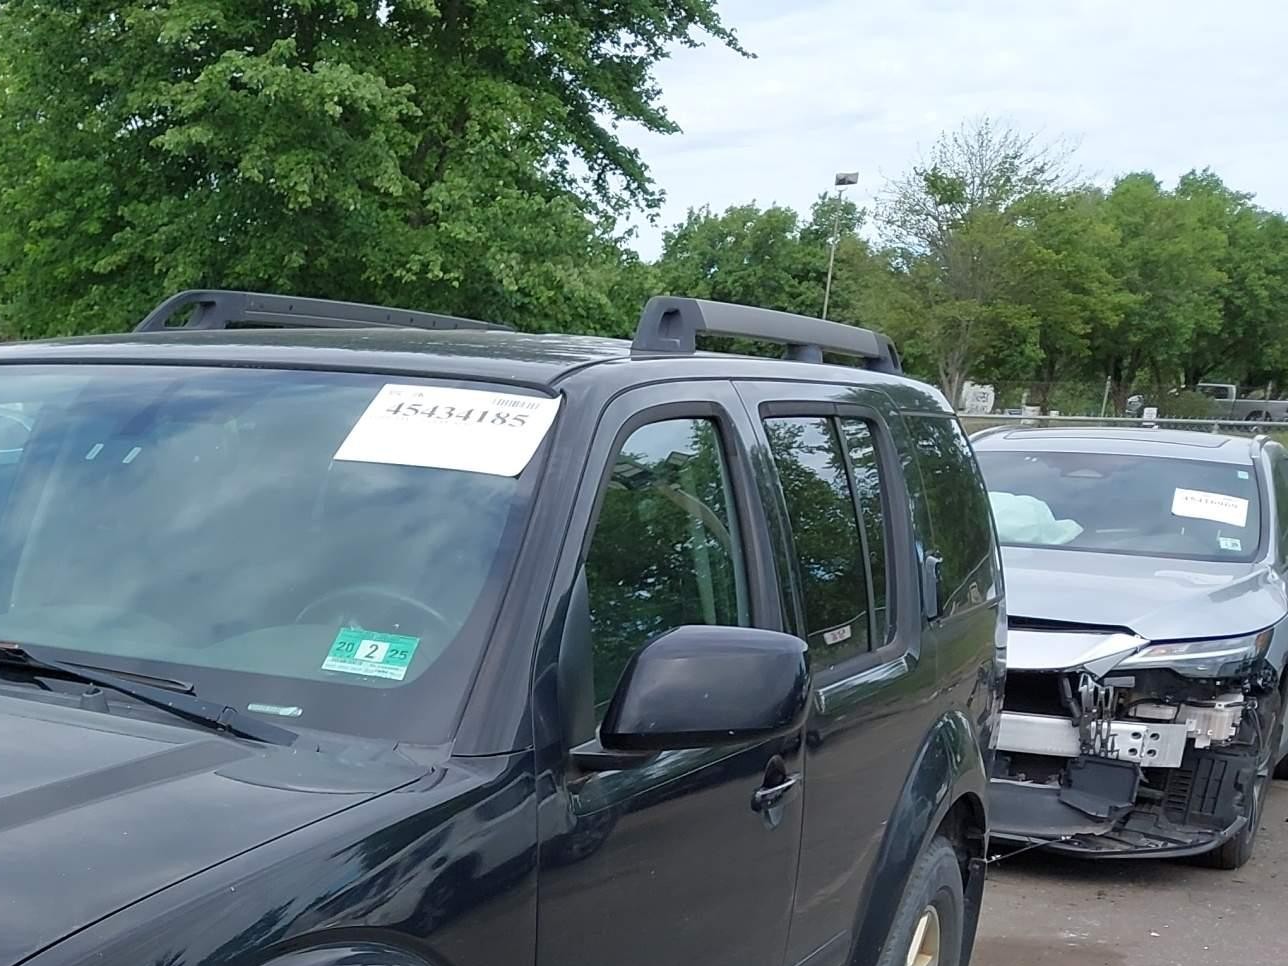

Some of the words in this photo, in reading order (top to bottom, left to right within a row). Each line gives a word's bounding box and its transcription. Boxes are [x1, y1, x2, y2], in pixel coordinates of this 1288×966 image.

[385, 402, 529, 428] 45434185
[336, 640, 354, 653] 20
[365, 643, 379, 659] 2
[388, 648, 409, 660] 25
